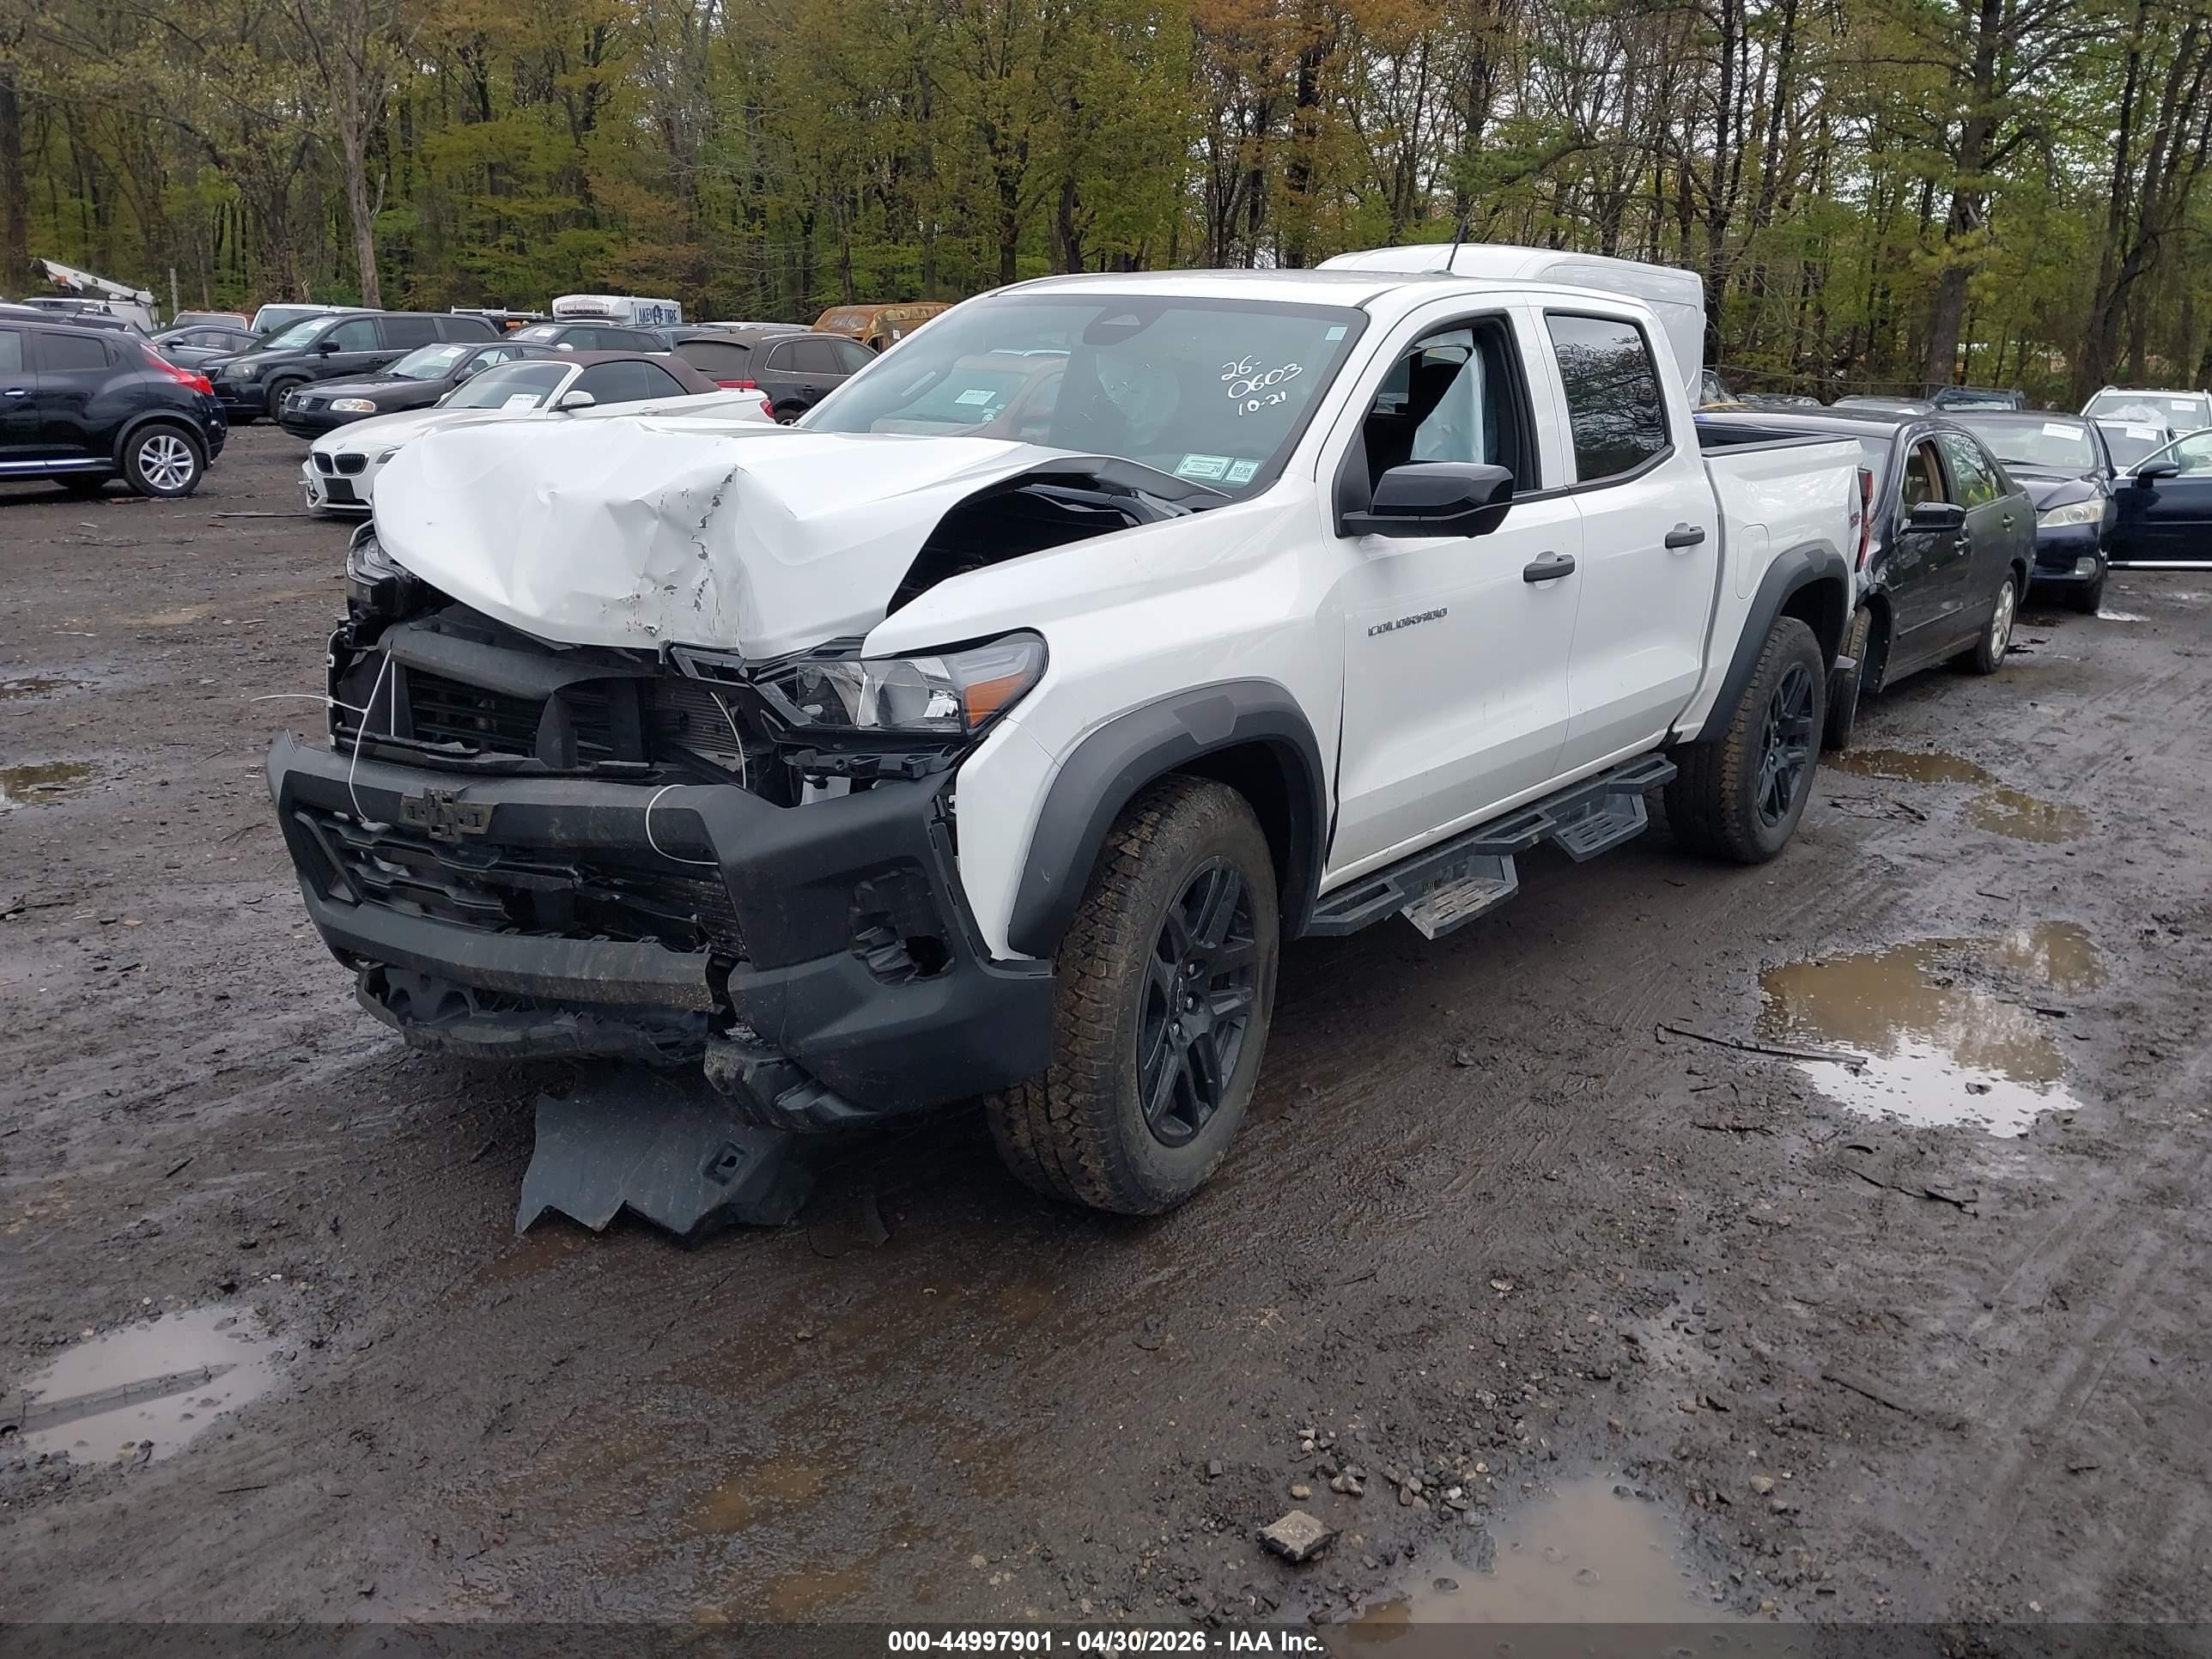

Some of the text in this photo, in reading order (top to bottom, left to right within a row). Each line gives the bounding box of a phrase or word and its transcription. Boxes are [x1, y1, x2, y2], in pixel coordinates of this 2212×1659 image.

[664, 308, 678, 323] TIRE
[1221, 355, 1262, 381] 26-
[1227, 362, 1304, 399] 0603
[1237, 391, 1287, 416] 10-21
[1368, 607, 1448, 637] COLORADO
